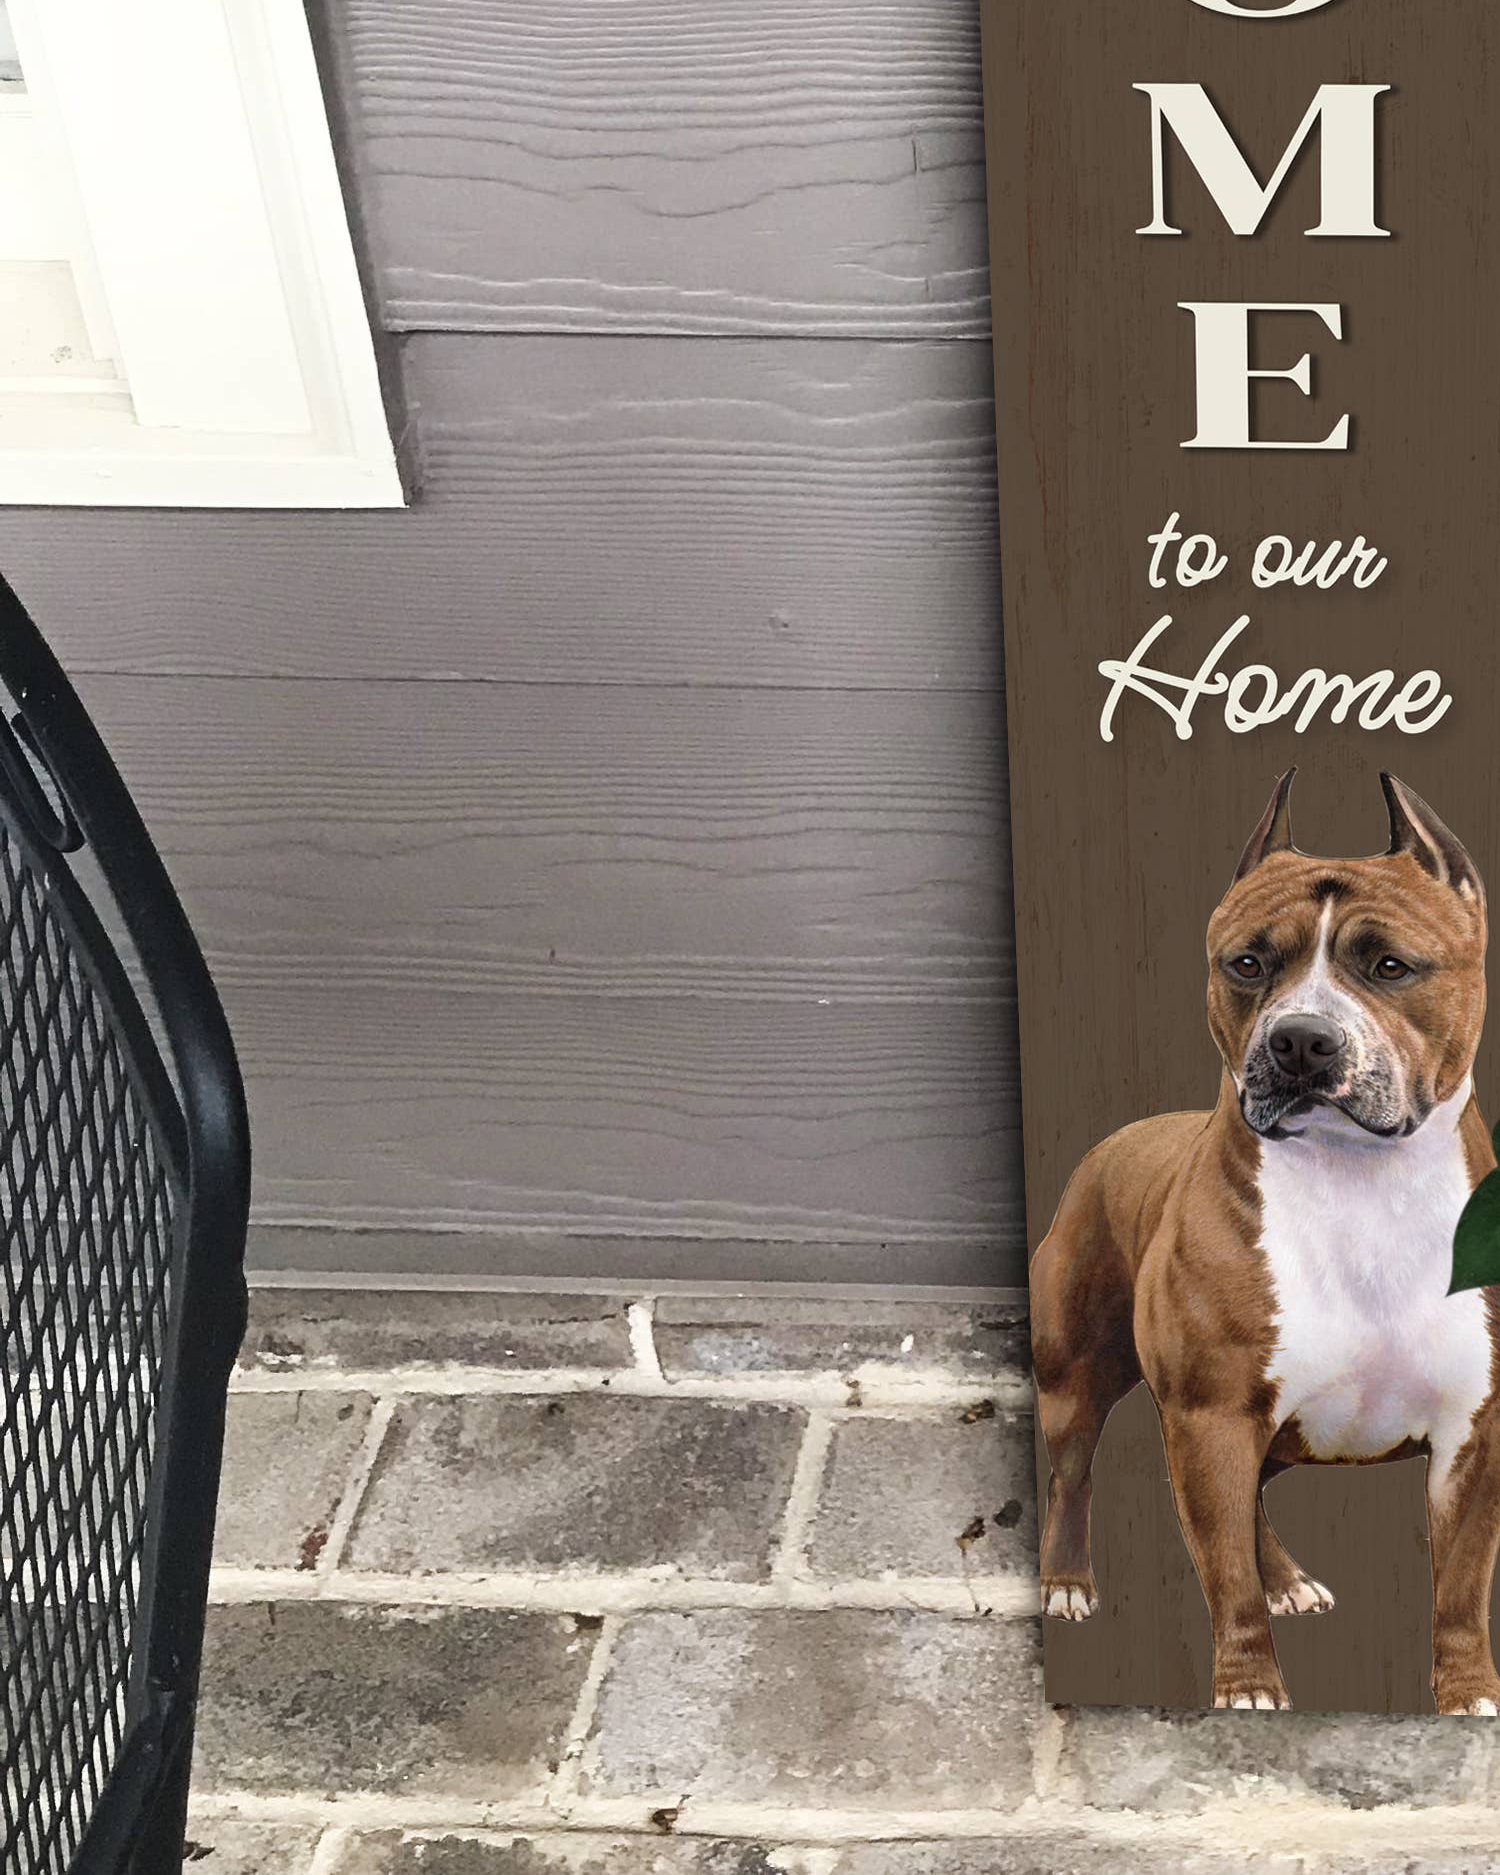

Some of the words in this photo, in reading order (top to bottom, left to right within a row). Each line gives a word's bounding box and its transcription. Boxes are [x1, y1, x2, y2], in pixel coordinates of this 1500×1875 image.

[1146, 511, 1229, 589] to
[1251, 534, 1388, 589] our
[1097, 614, 1453, 743] Home
